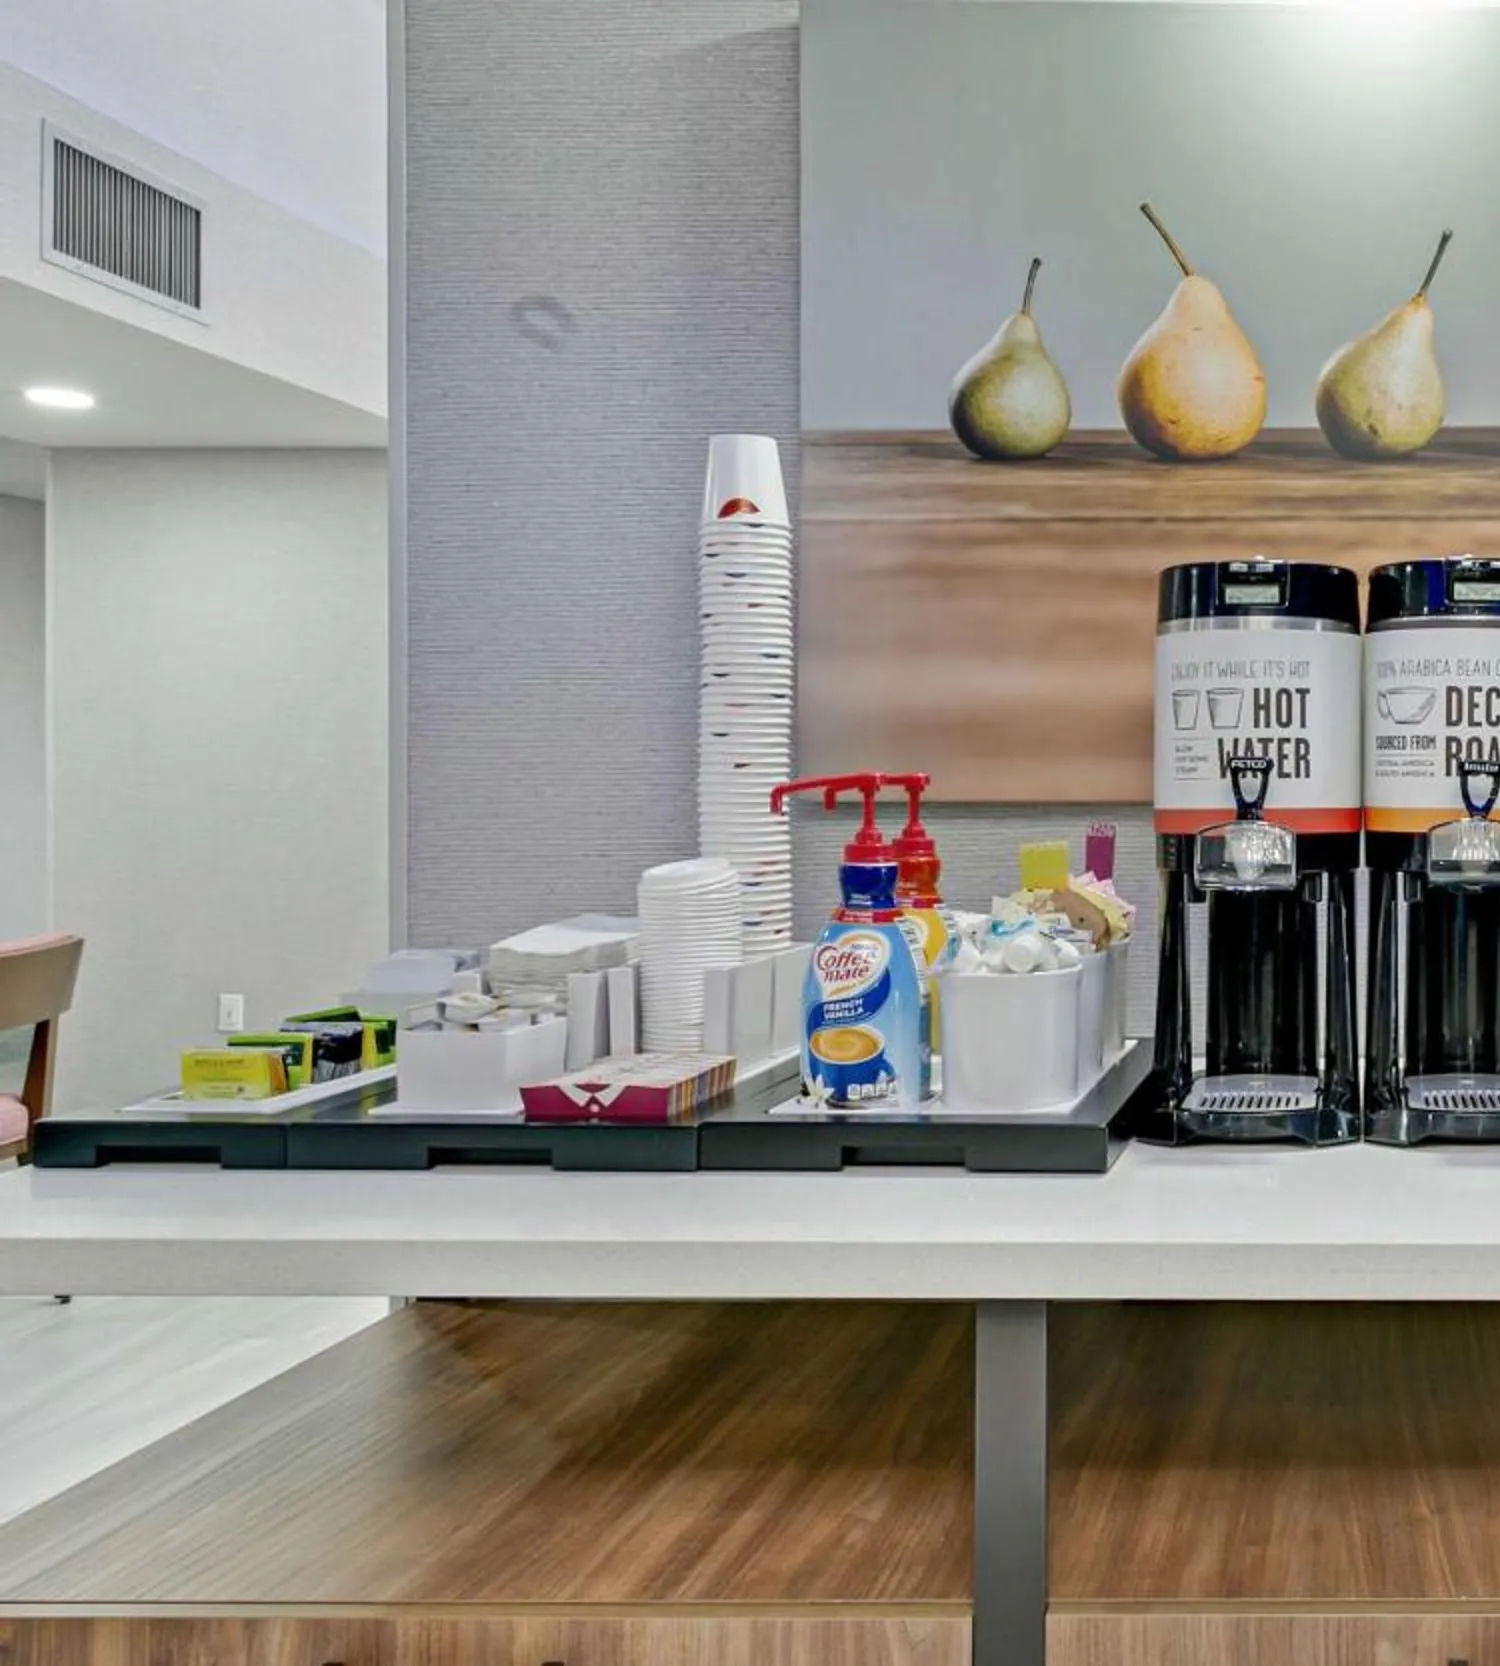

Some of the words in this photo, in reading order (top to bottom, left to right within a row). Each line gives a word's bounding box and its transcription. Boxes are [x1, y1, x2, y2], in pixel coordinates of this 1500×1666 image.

[1217, 660, 1255, 679] WHILE
[1289, 660, 1311, 679] HOT
[1399, 659, 1451, 678] ARABICA
[1456, 659, 1491, 677] BEAN
[1253, 687, 1311, 729] HOT
[1409, 735, 1437, 751] FROM
[1217, 738, 1311, 779] WATER
